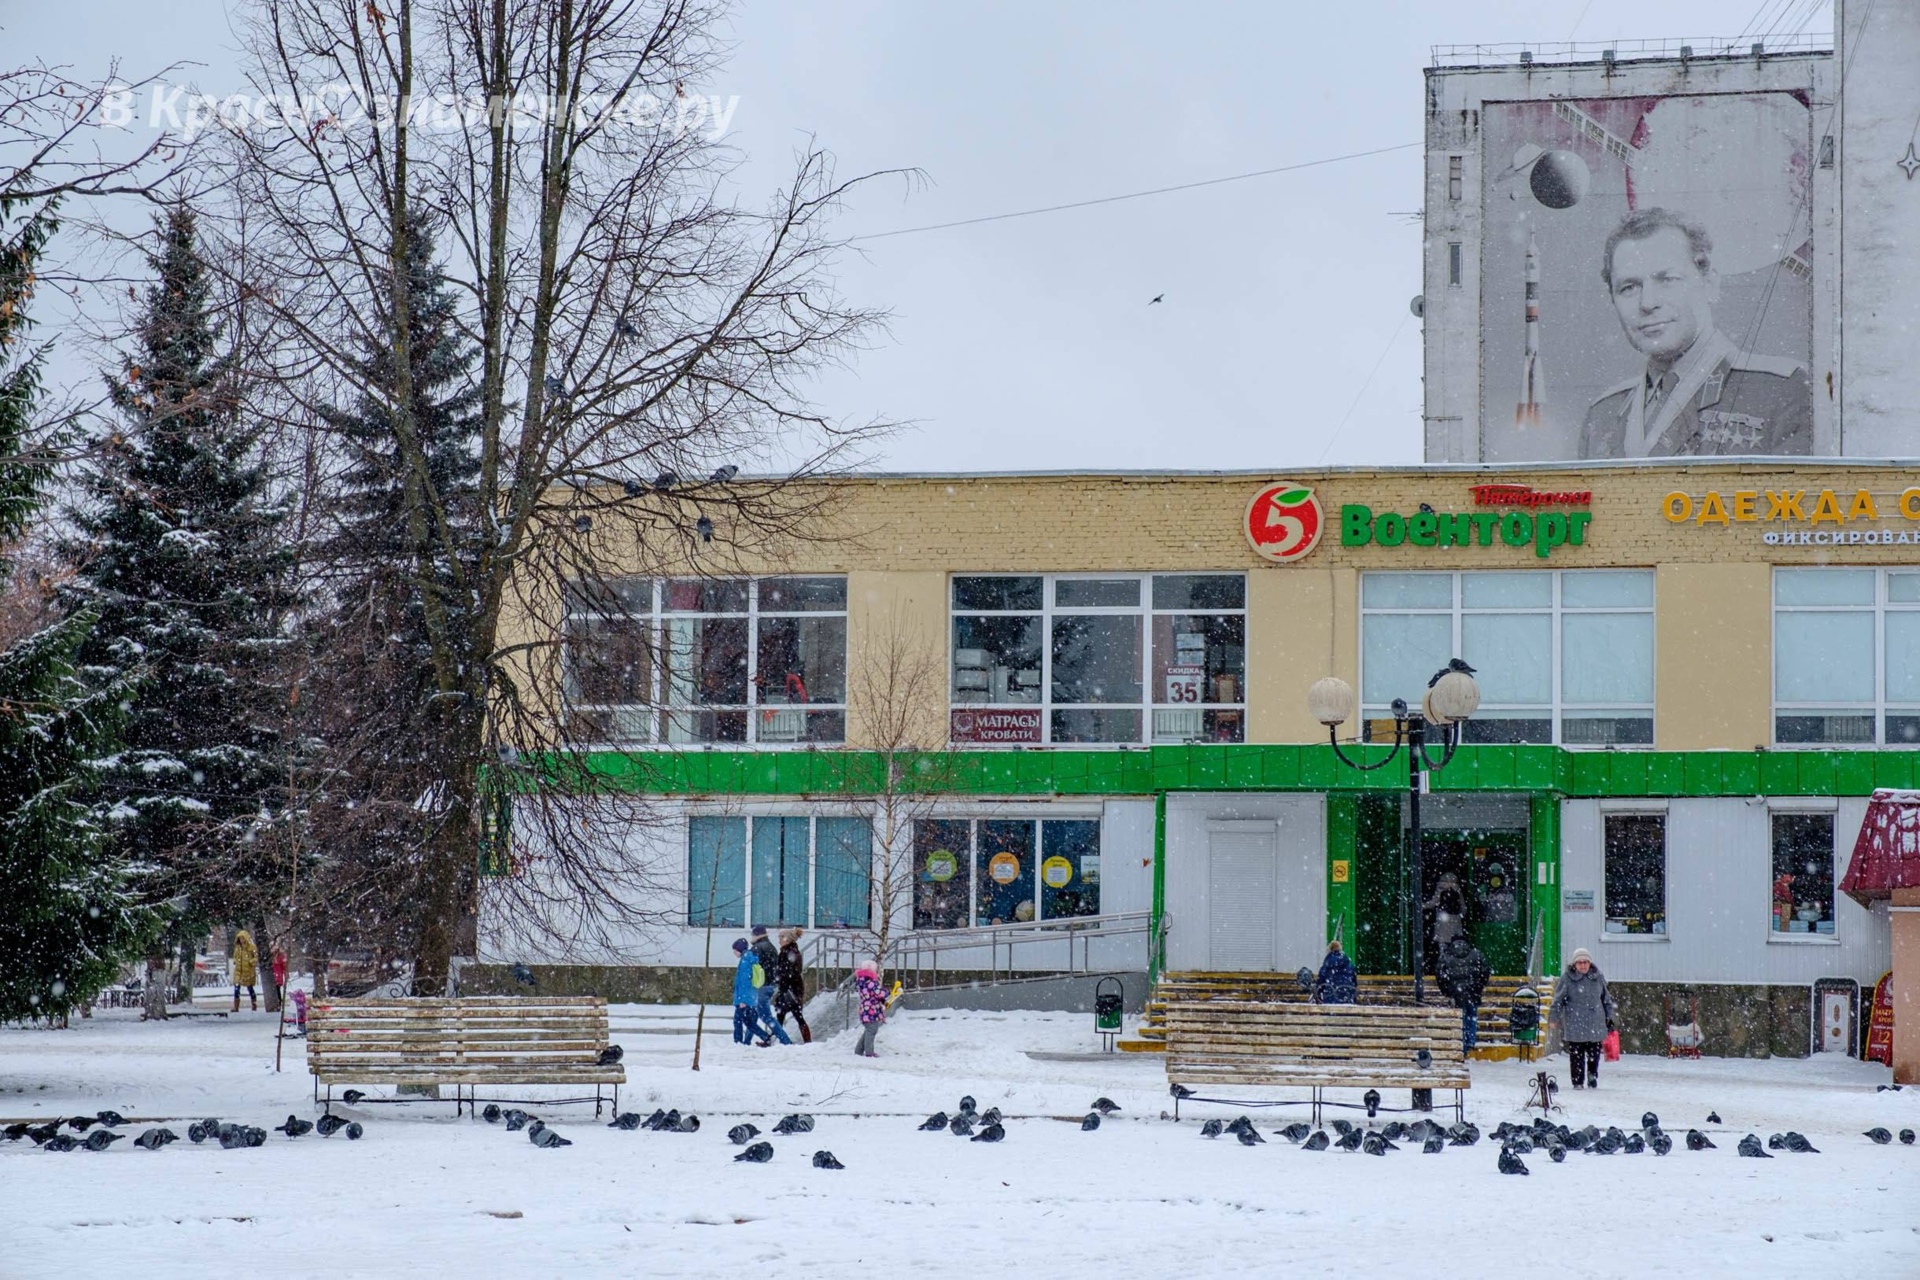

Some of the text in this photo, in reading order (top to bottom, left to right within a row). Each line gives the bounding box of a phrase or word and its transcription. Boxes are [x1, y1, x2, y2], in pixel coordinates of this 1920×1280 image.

[1662, 488, 1878, 527] ОДЕЖДА
[1170, 681, 1198, 703] 35
[976, 715, 1040, 728] МАТРАСЫ
[981, 730, 1033, 740] КРОВАТИ
